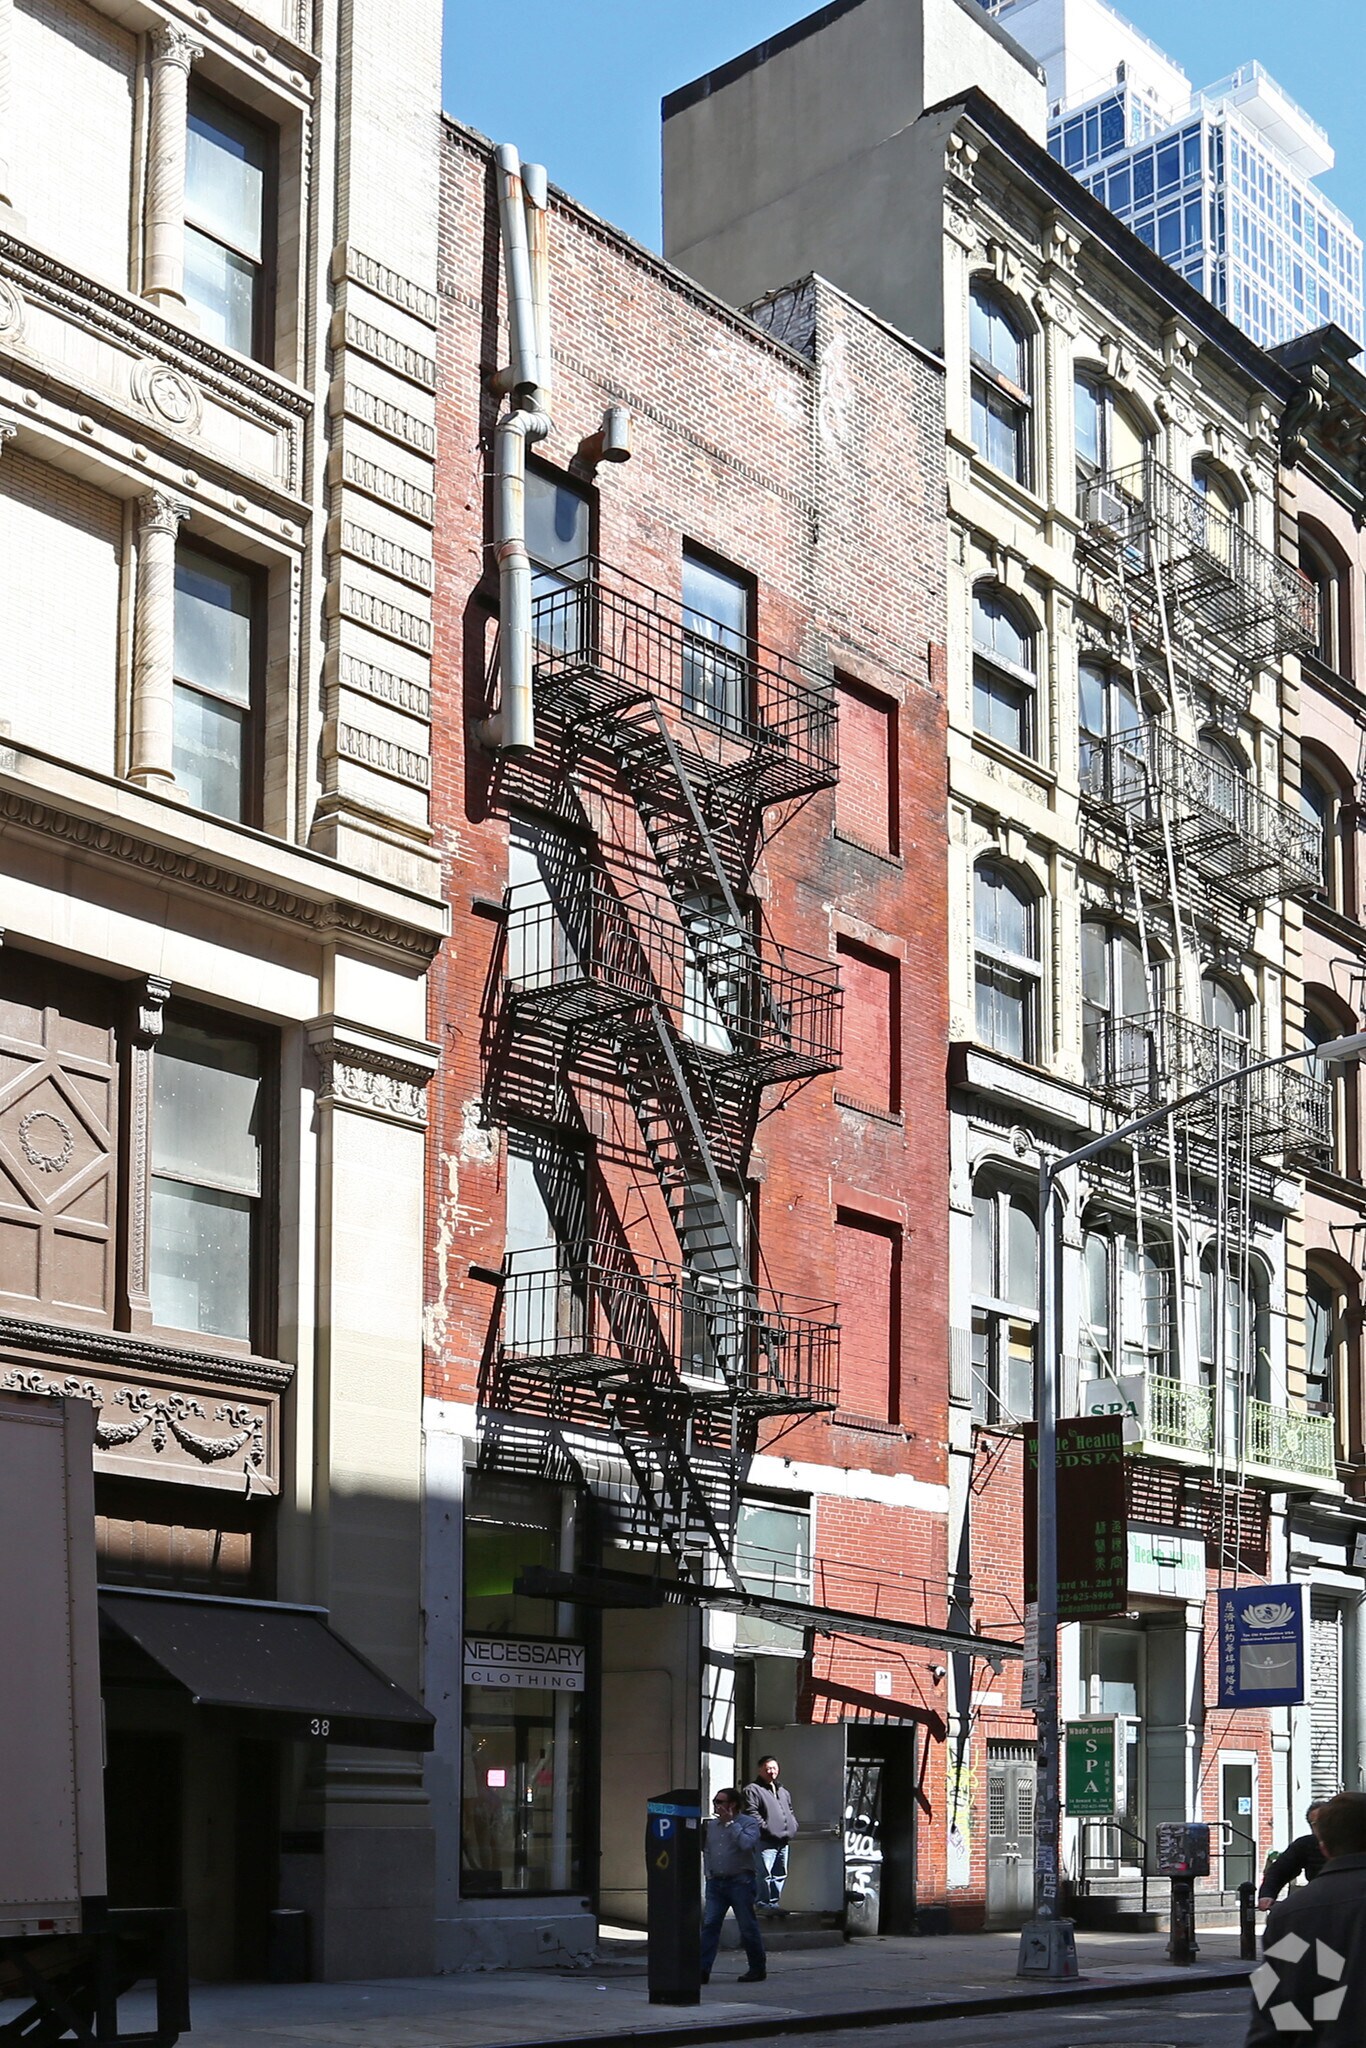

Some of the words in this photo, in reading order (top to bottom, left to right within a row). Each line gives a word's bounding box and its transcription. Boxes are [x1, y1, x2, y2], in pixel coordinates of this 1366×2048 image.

[1091, 1401, 1139, 1416] SPA
[1028, 1437, 1069, 1453] Wle
[1076, 1432, 1120, 1449] Health
[464, 1641, 583, 1666] NECESSARY
[471, 1671, 576, 1687] CLOTHING
[311, 1718, 330, 1736] 38
[1069, 1727, 1089, 1735] Whole
[660, 1818, 671, 1837] P
